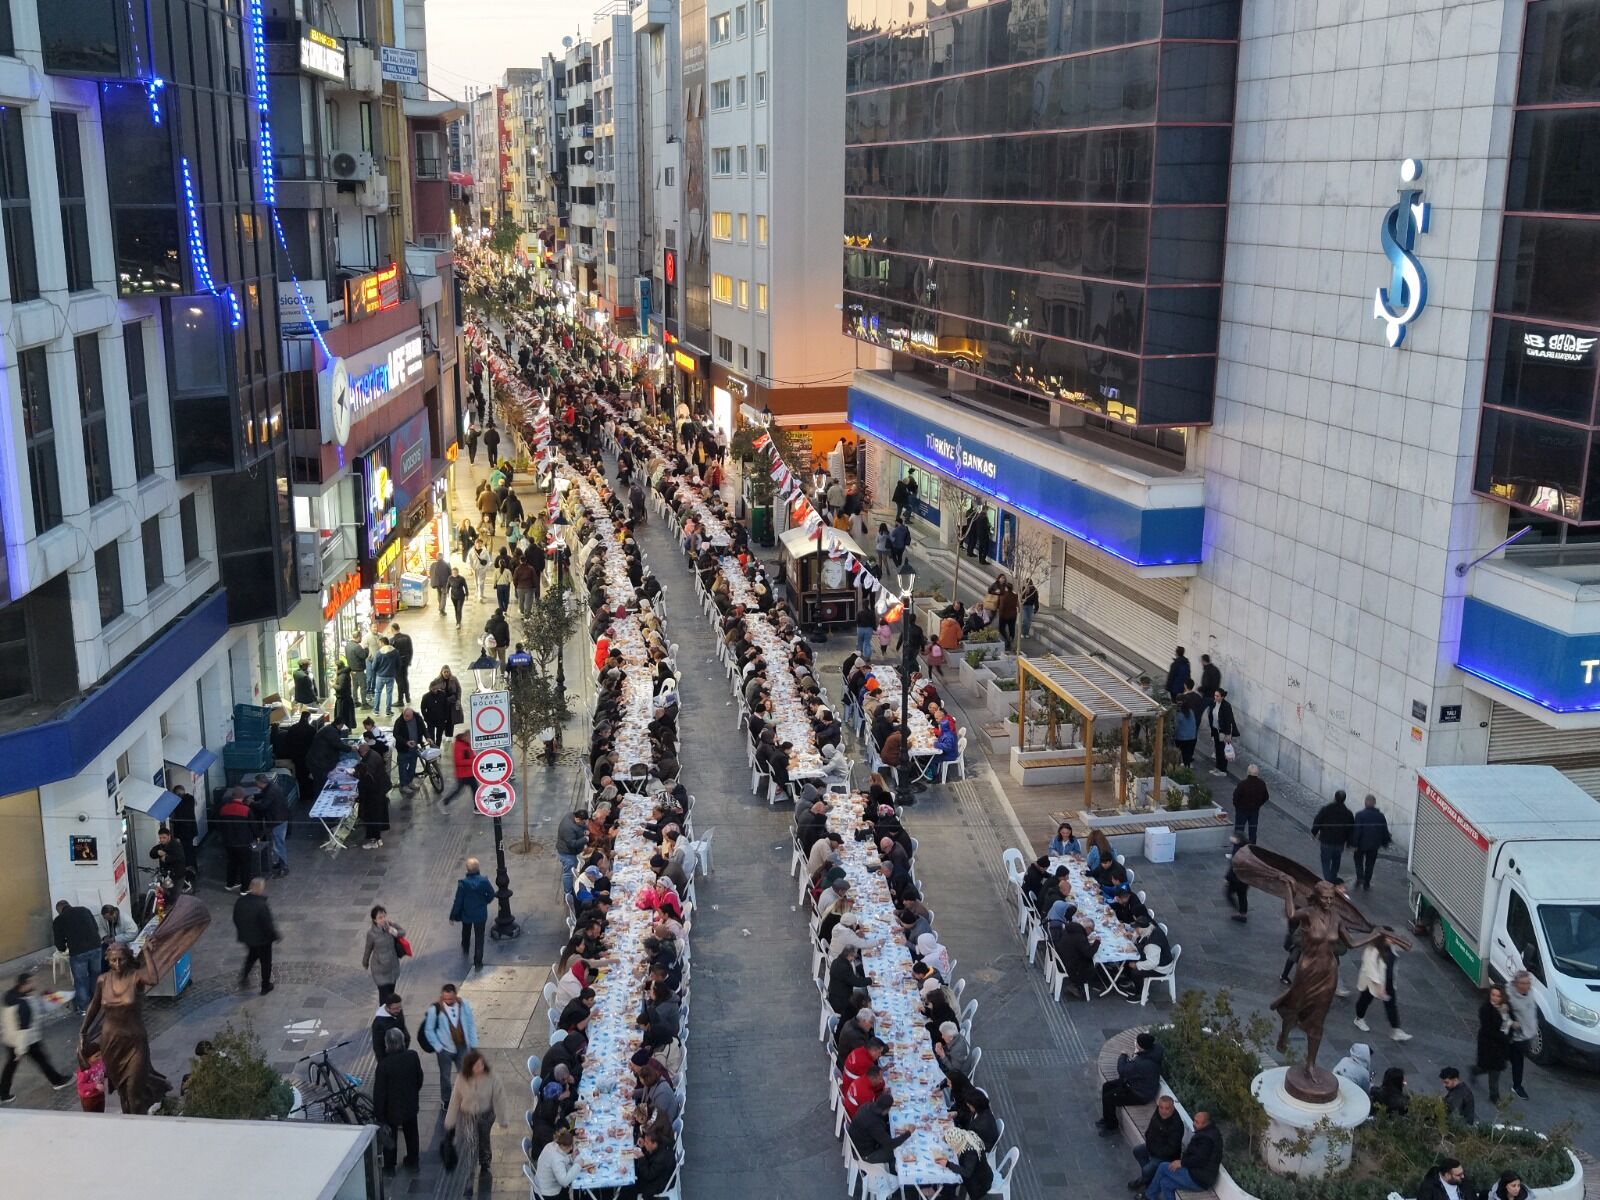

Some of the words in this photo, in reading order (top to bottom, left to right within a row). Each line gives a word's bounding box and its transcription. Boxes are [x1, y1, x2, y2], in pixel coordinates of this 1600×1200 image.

[280, 293, 315, 305] SİGOTA
[926, 433, 955, 460] TÜRKİYE
[962, 451, 996, 479] BANKASI
[1580, 659, 1600, 684] T
